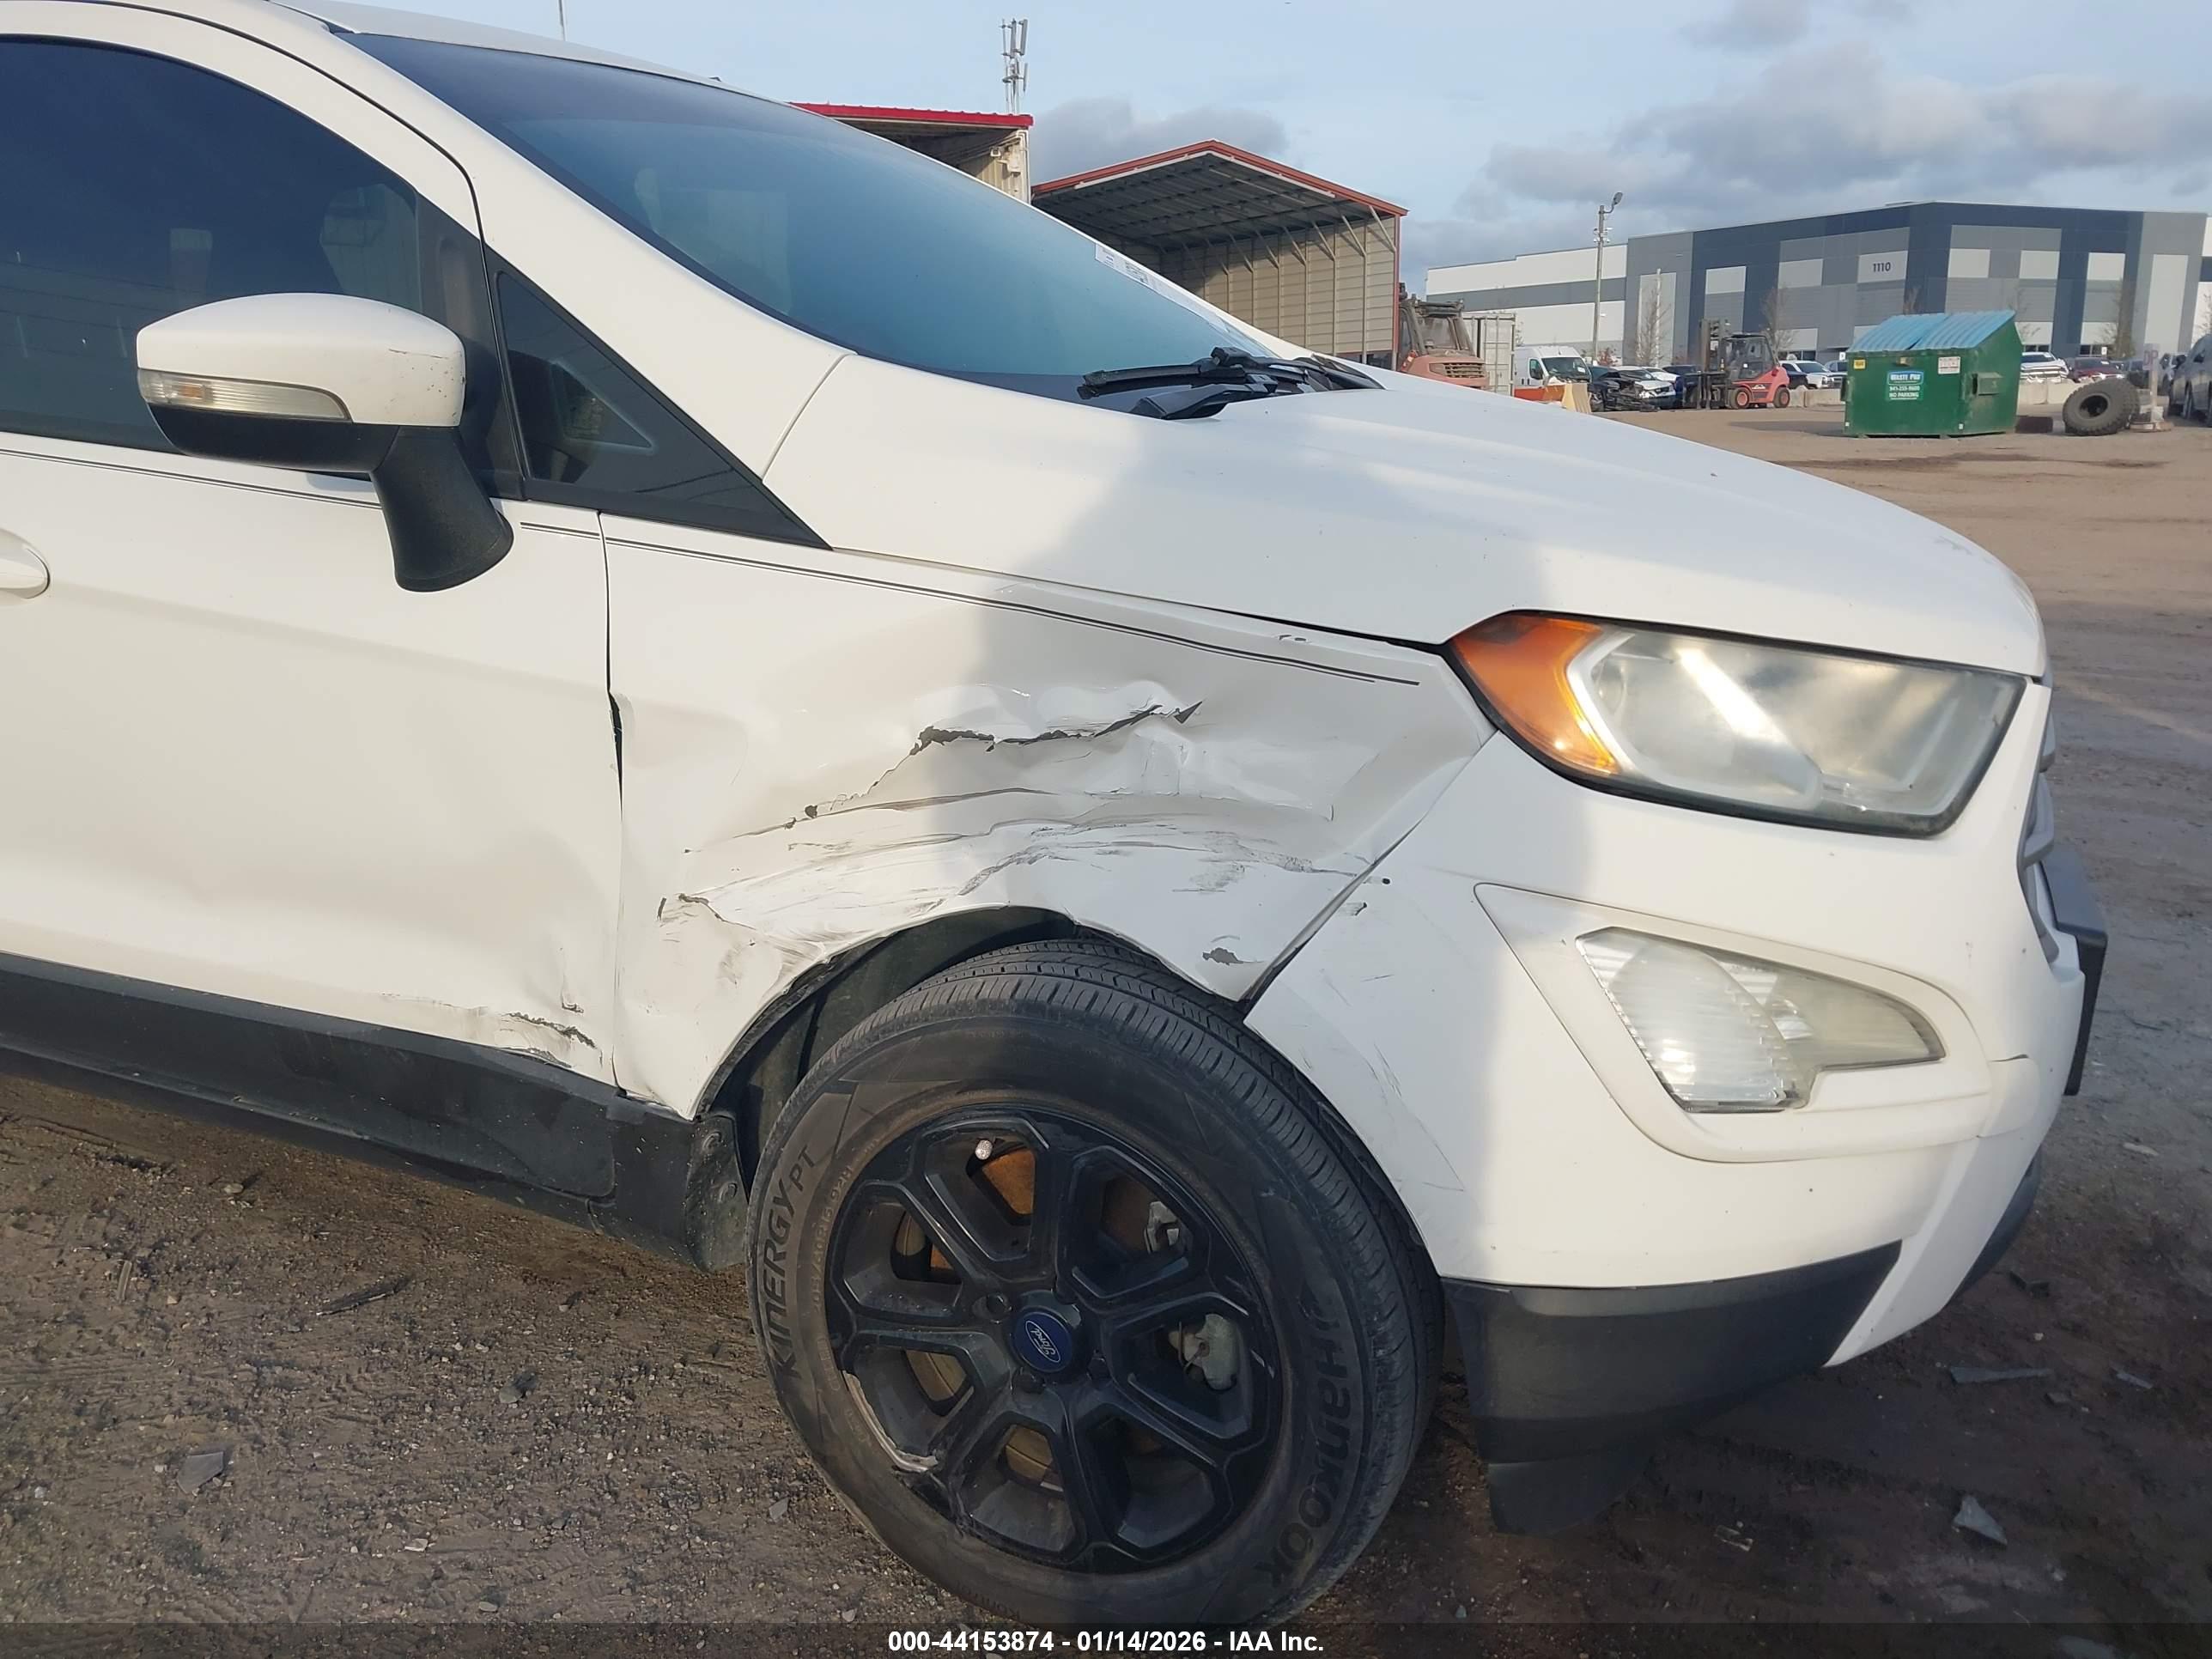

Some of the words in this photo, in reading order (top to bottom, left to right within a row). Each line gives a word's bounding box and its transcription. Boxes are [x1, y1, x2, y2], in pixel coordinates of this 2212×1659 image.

[1873, 262, 1891, 272] 1110
[789, 1145, 816, 1192] PT
[1030, 1328, 1056, 1355] Ford
